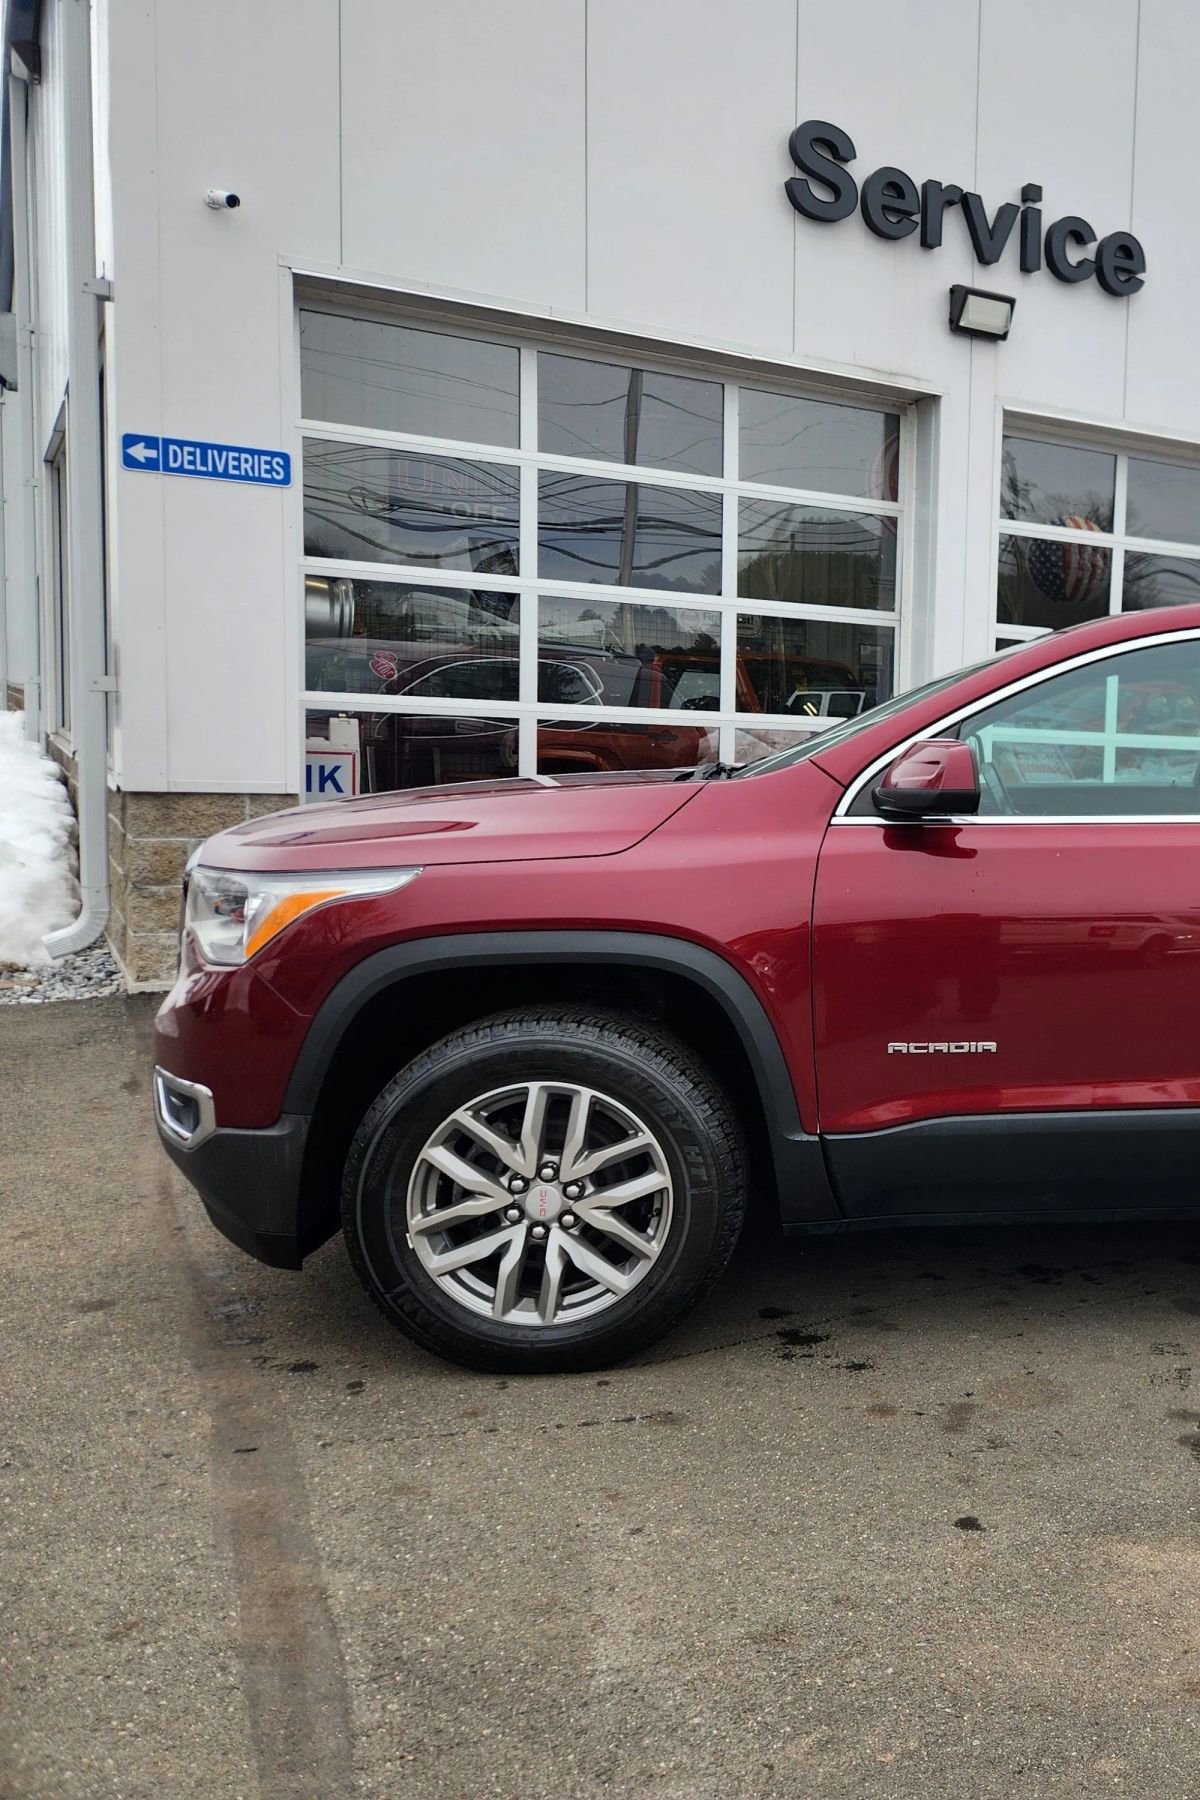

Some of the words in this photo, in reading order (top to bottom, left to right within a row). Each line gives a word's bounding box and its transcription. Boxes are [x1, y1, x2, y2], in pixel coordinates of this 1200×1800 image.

[784, 119, 1146, 297] Service
[169, 444, 284, 480] DELIVERIES
[887, 1042, 997, 1054] ACADIA
[539, 1189, 548, 1217] GMC
